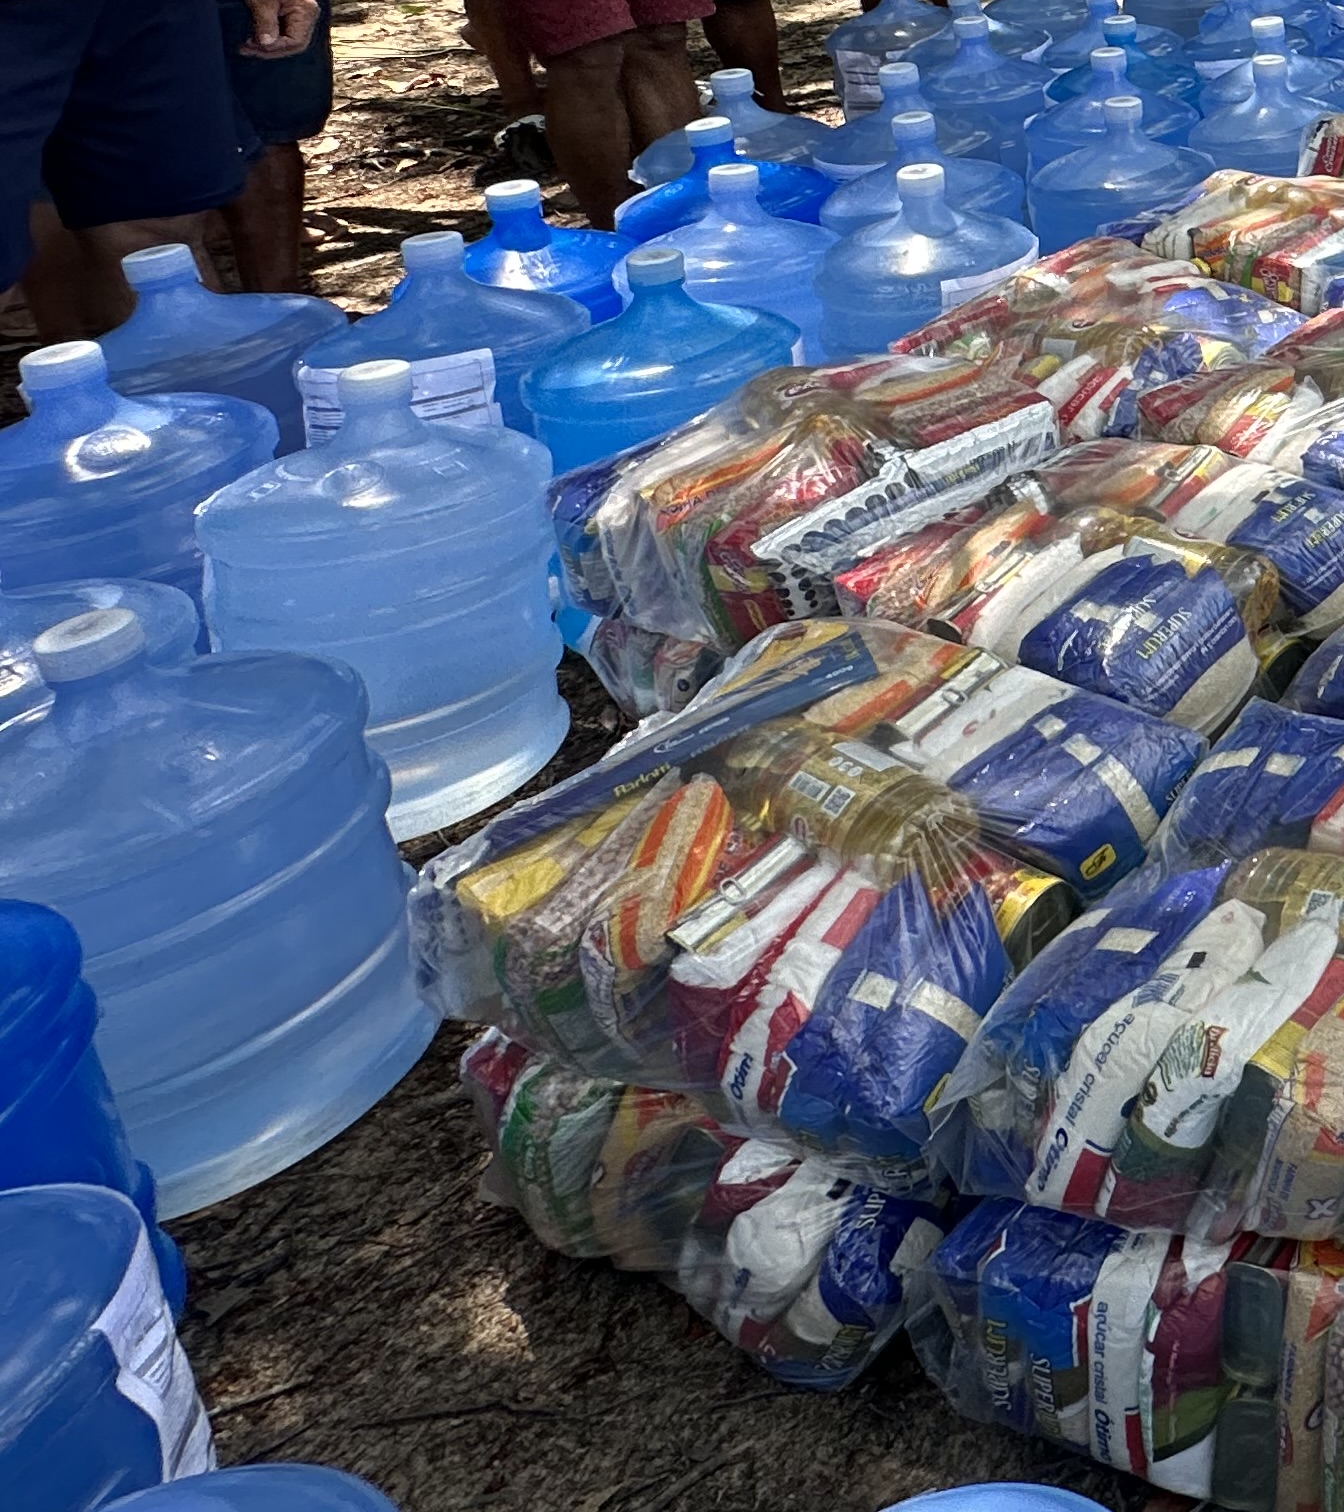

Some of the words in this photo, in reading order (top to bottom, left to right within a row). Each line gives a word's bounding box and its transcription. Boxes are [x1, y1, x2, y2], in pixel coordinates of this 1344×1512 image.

[1136, 606, 1192, 660] SUPERUM
[1095, 1013, 1136, 1070] açúcar
[1066, 1073, 1096, 1129] cristal
[1037, 1127, 1069, 1192] Ótimo
